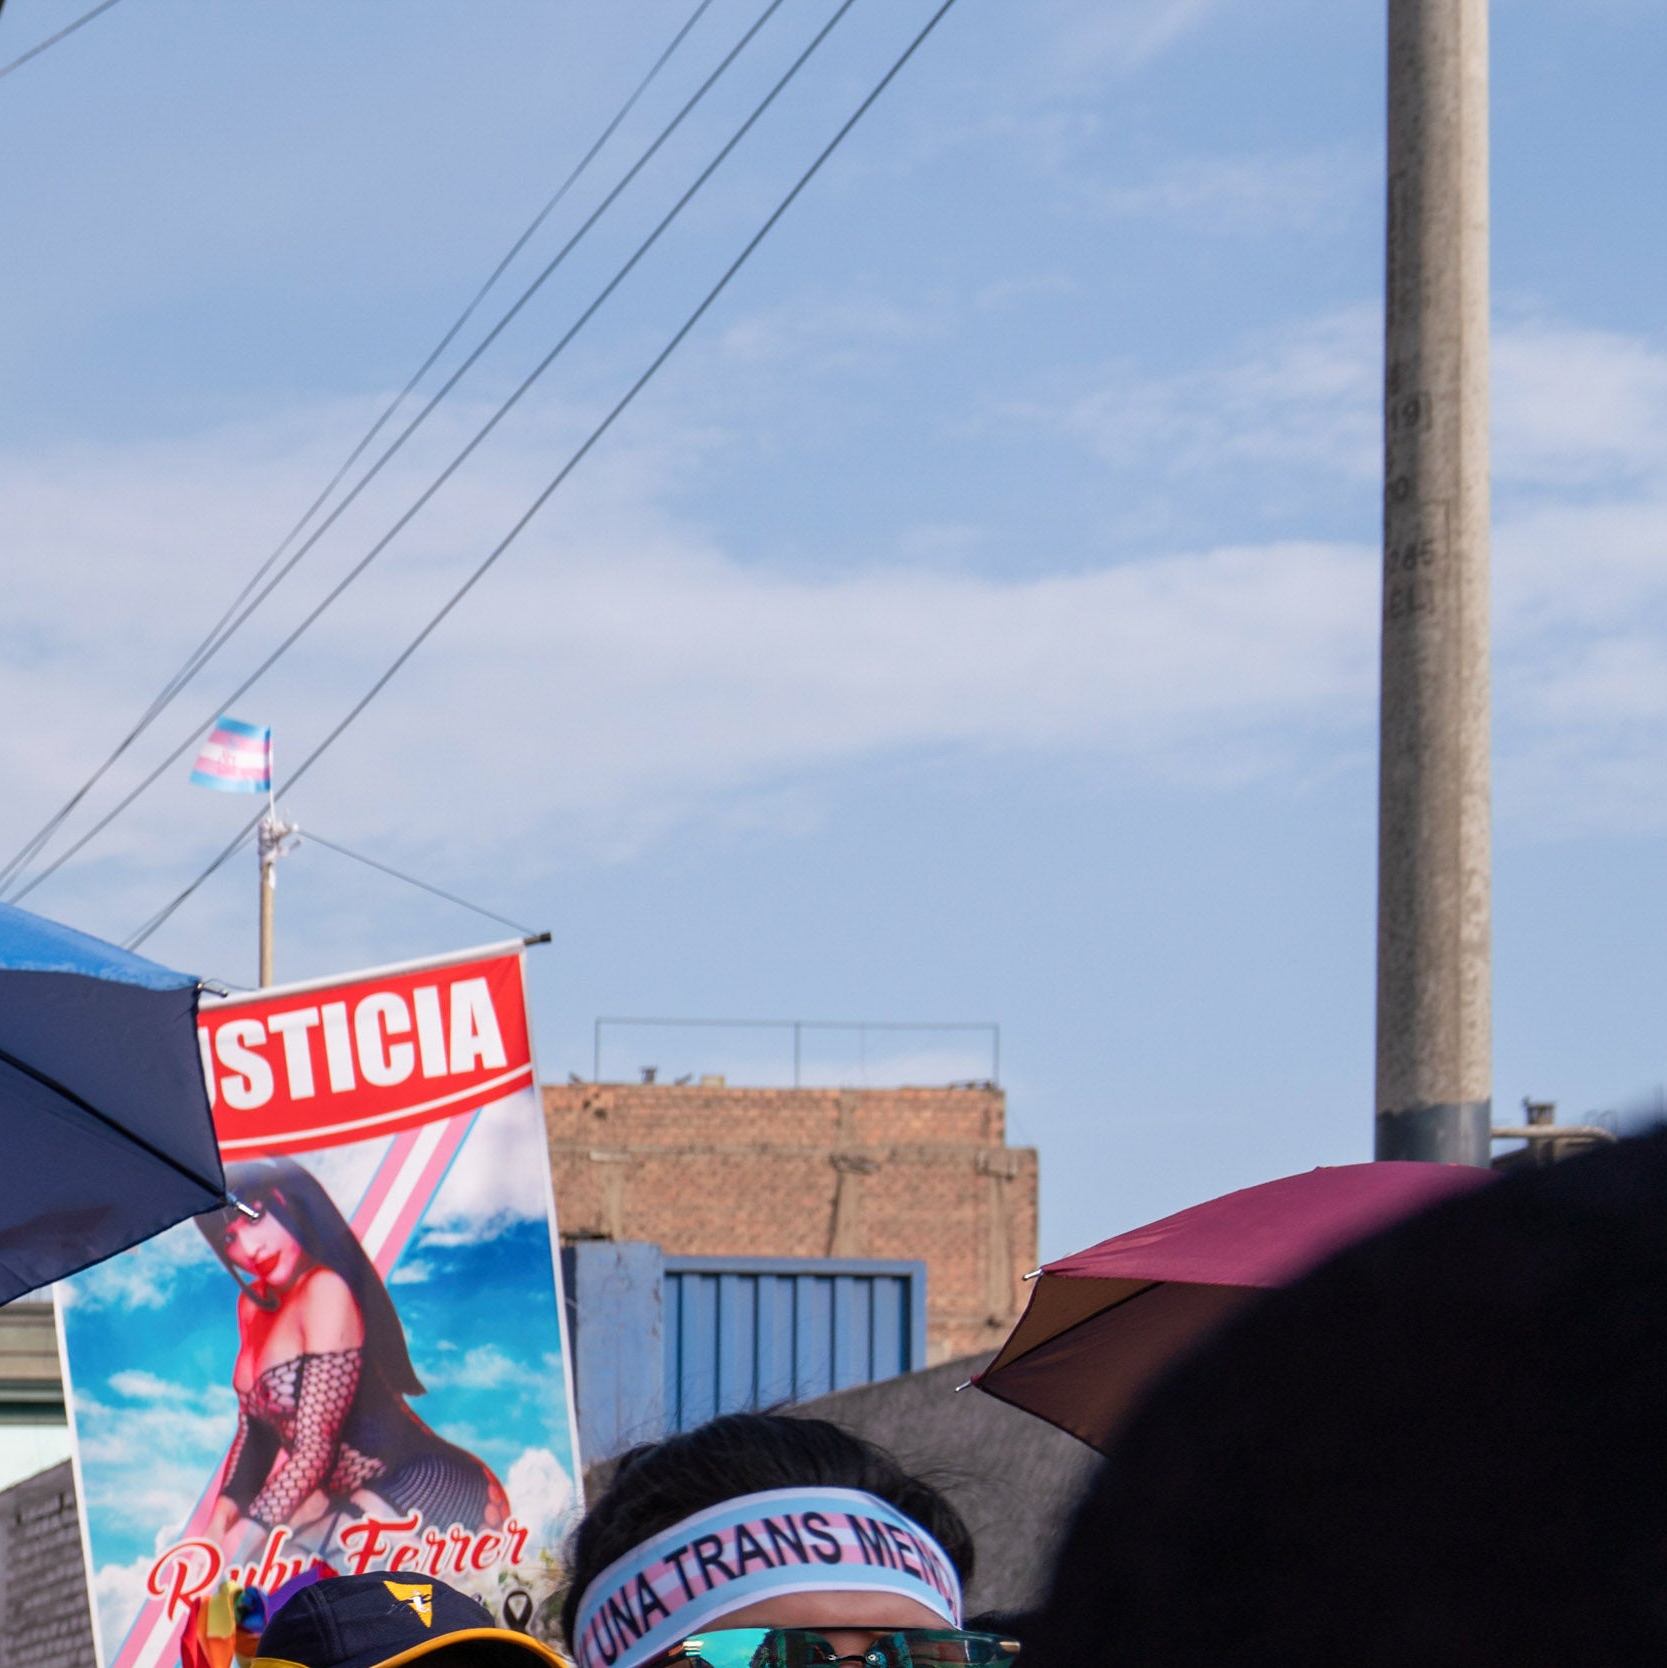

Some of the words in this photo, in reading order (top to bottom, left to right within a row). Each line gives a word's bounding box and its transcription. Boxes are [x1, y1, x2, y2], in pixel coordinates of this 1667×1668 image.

[340, 1513, 530, 1575] Ferrer
[590, 1573, 669, 1666] UNA
[664, 1510, 842, 1601] TRANS
